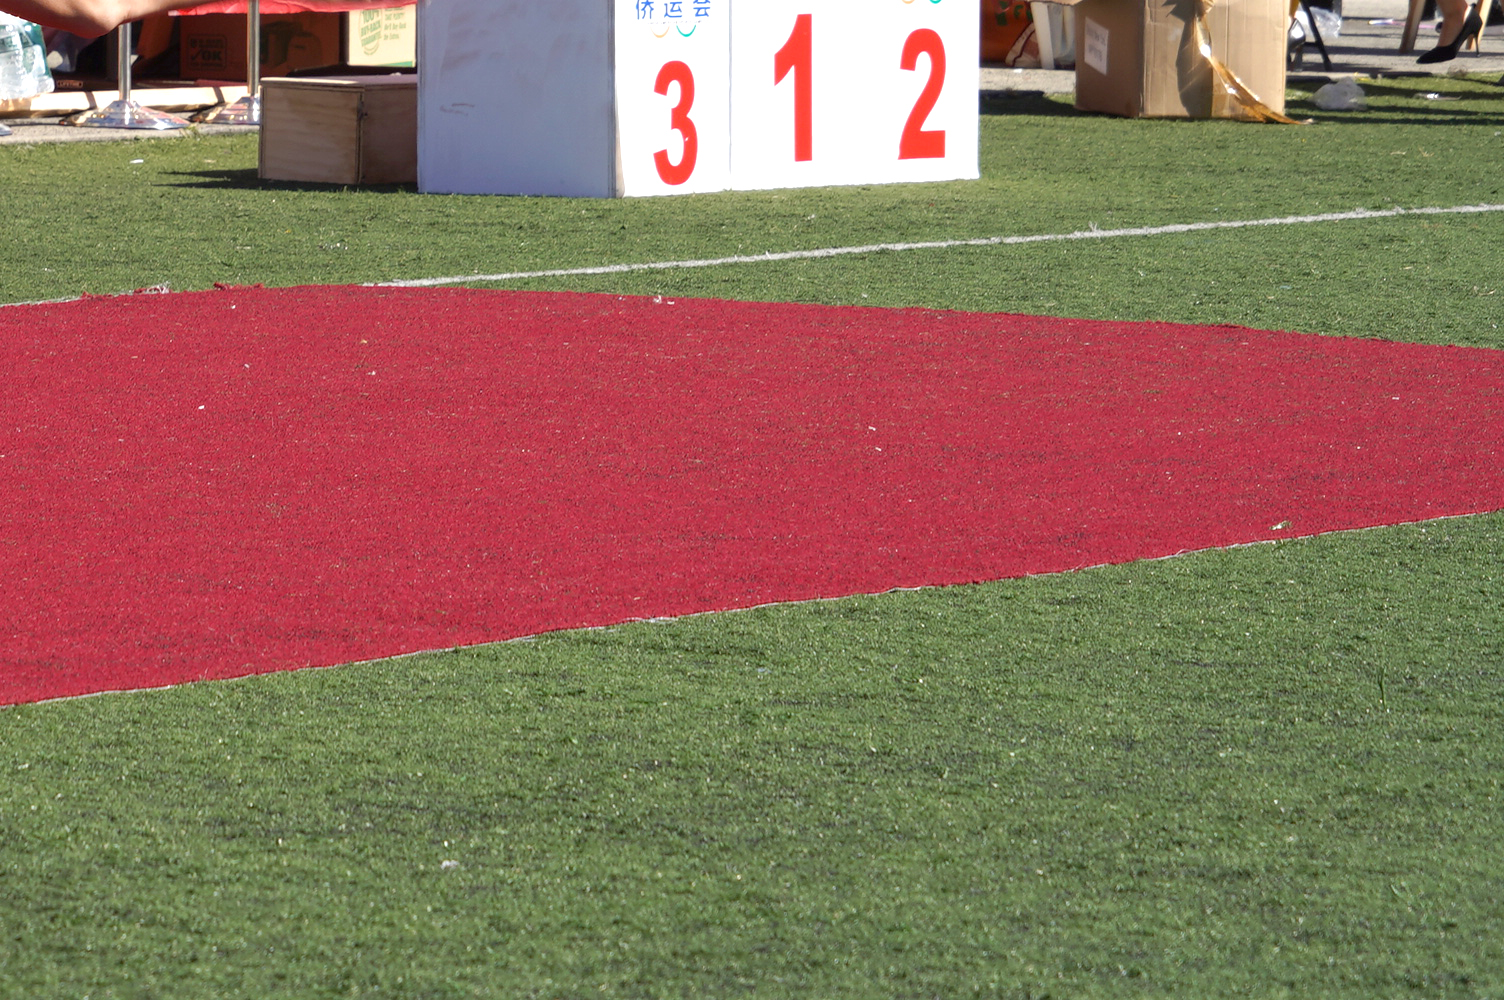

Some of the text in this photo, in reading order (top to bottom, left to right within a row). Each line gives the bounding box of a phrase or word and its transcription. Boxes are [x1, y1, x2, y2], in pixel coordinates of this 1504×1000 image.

[653, 60, 698, 186] 3
[774, 14, 812, 162] 1
[898, 28, 946, 160] 2
